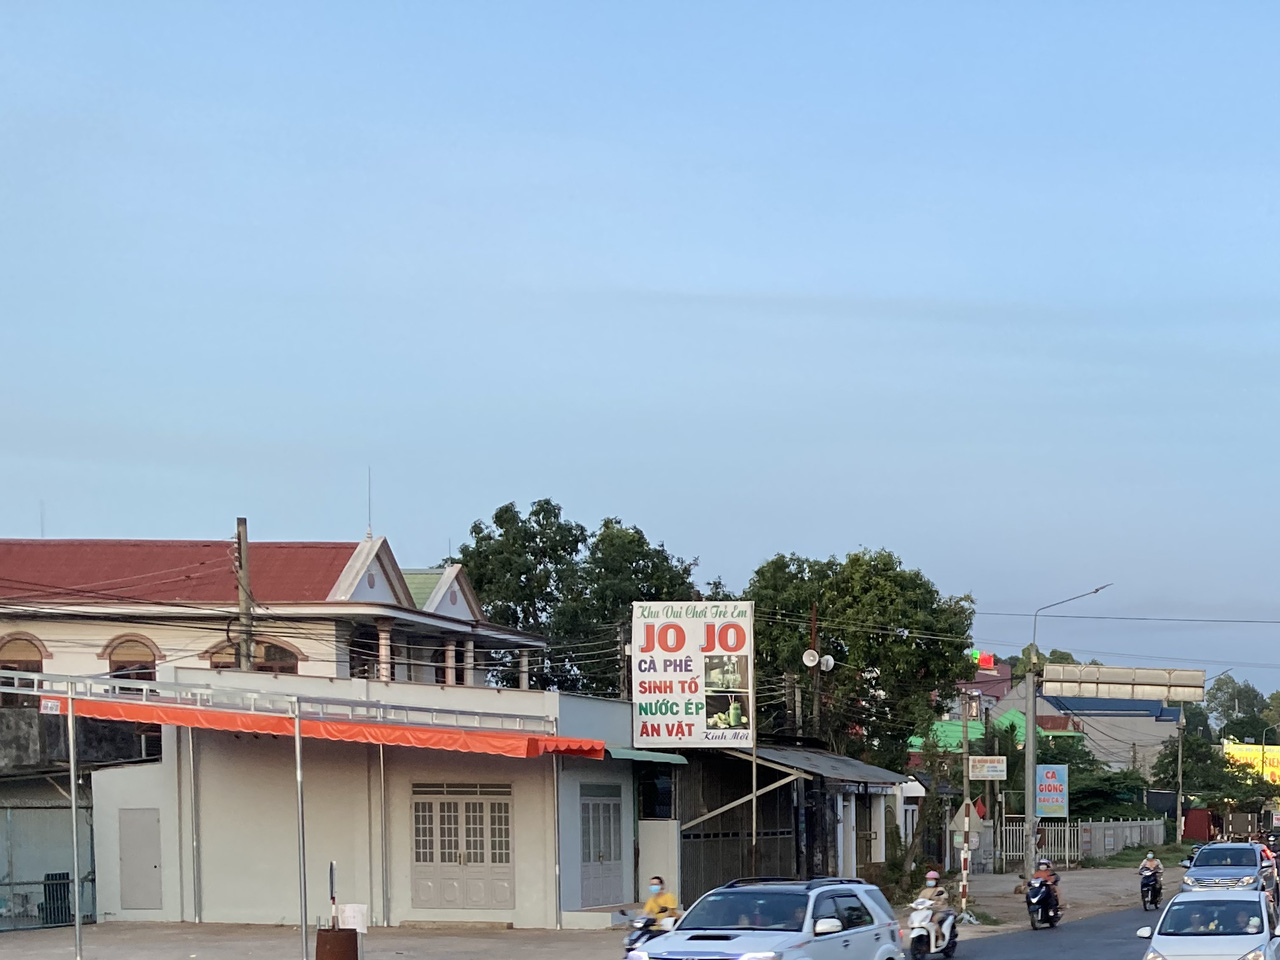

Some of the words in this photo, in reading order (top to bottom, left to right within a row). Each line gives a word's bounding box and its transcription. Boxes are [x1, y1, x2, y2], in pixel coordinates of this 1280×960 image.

[637, 605, 659, 619] Khu
[662, 605, 683, 619] Vui
[685, 605, 708, 619] Chơi
[710, 605, 728, 619] Trẻ
[731, 605, 748, 619] Em
[639, 621, 686, 653] JO
[699, 621, 746, 653] JO
[638, 656, 657, 672] CÀ
[663, 656, 693, 672] PHÊ
[638, 680, 674, 694] SINH
[678, 675, 700, 694] TỐ
[638, 699, 680, 716] NƯỚC
[684, 698, 705, 715] ÉP
[640, 721, 661, 737] ĂN
[665, 720, 695, 740] VẶT
